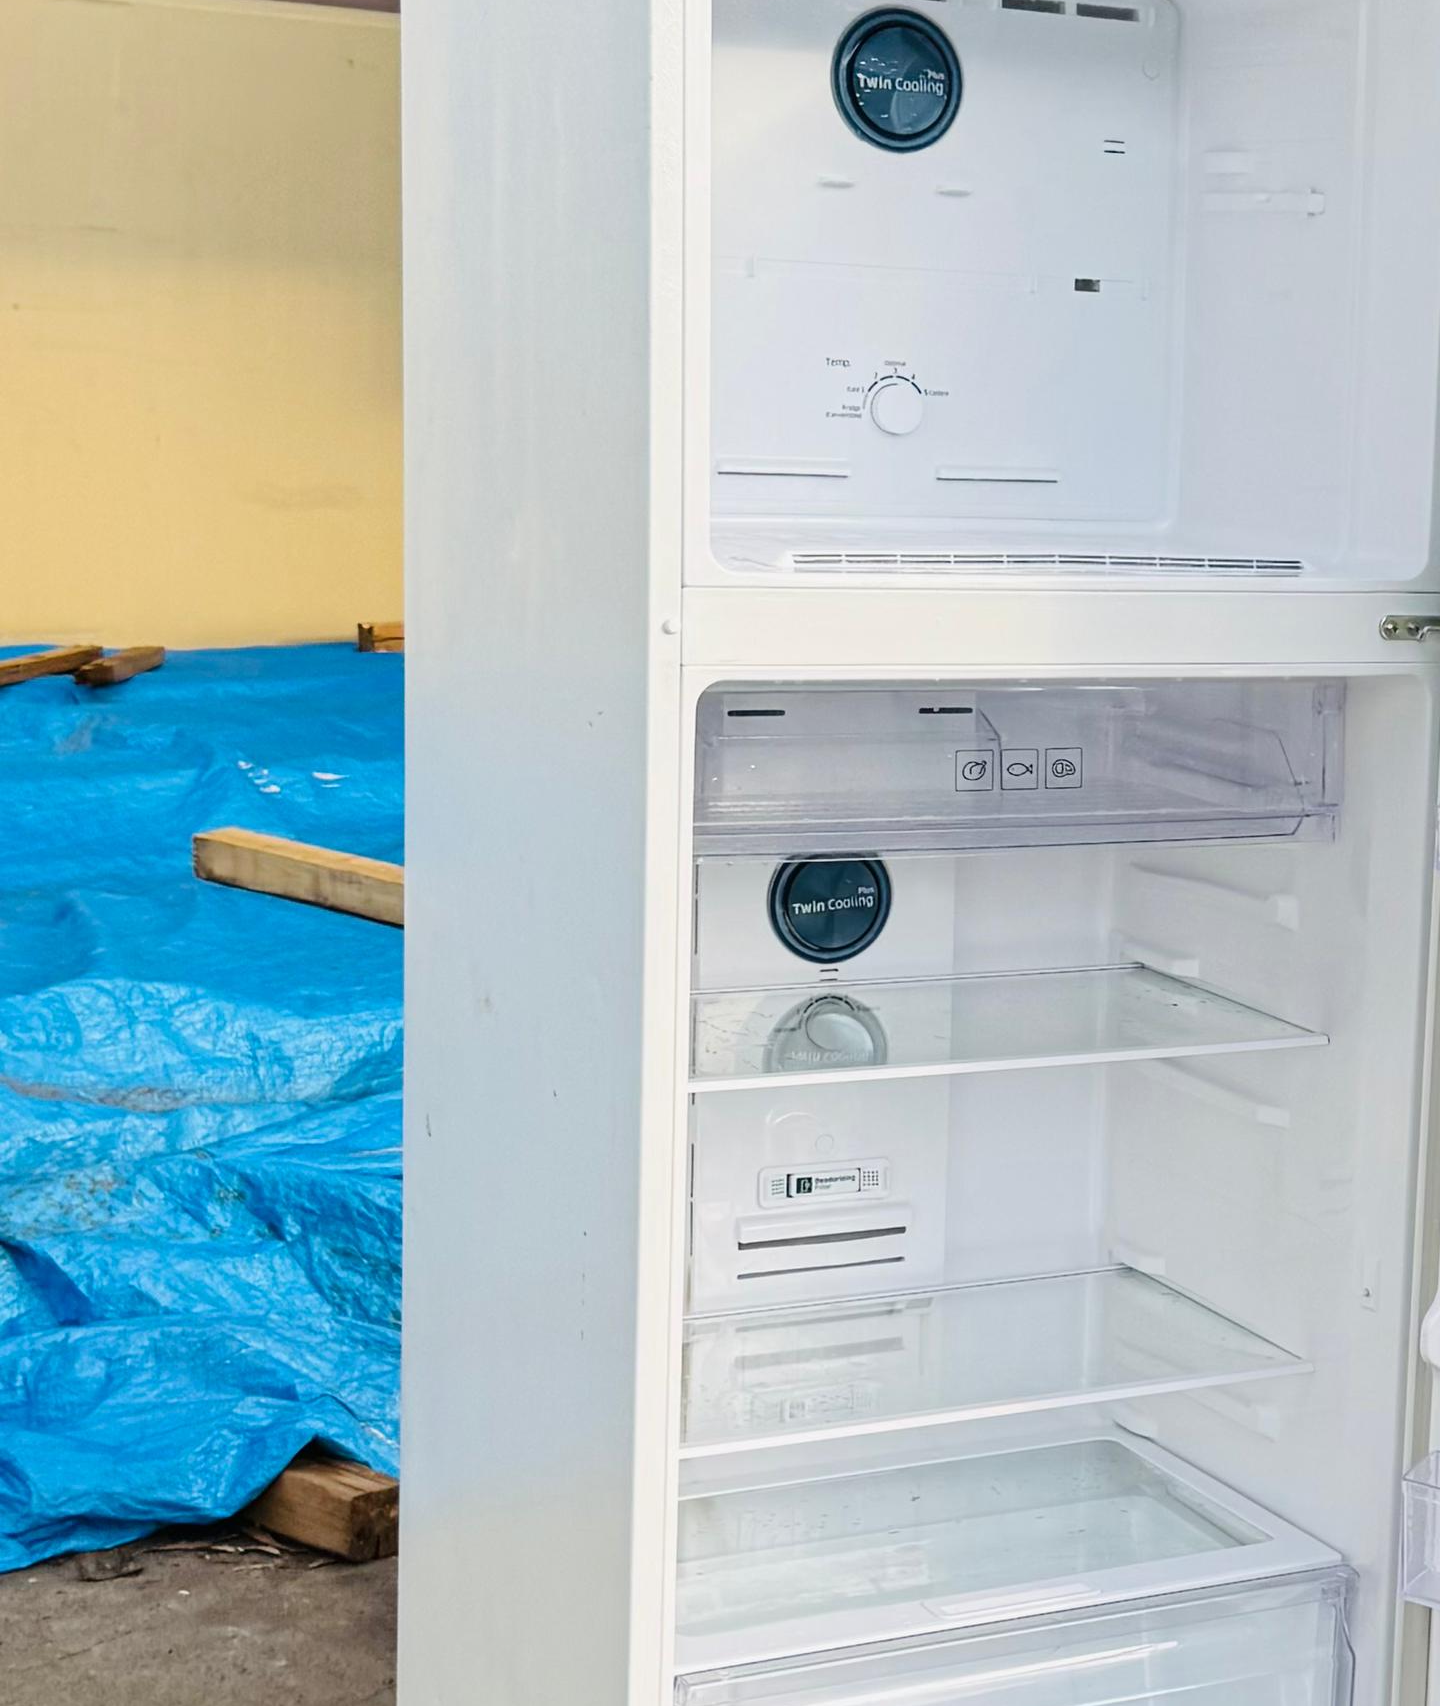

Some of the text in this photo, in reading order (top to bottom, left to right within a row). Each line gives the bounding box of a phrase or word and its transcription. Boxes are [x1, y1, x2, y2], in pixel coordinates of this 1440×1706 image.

[857, 74, 944, 96] Twin Cooling
[792, 895, 874, 915] Twin Cooling
